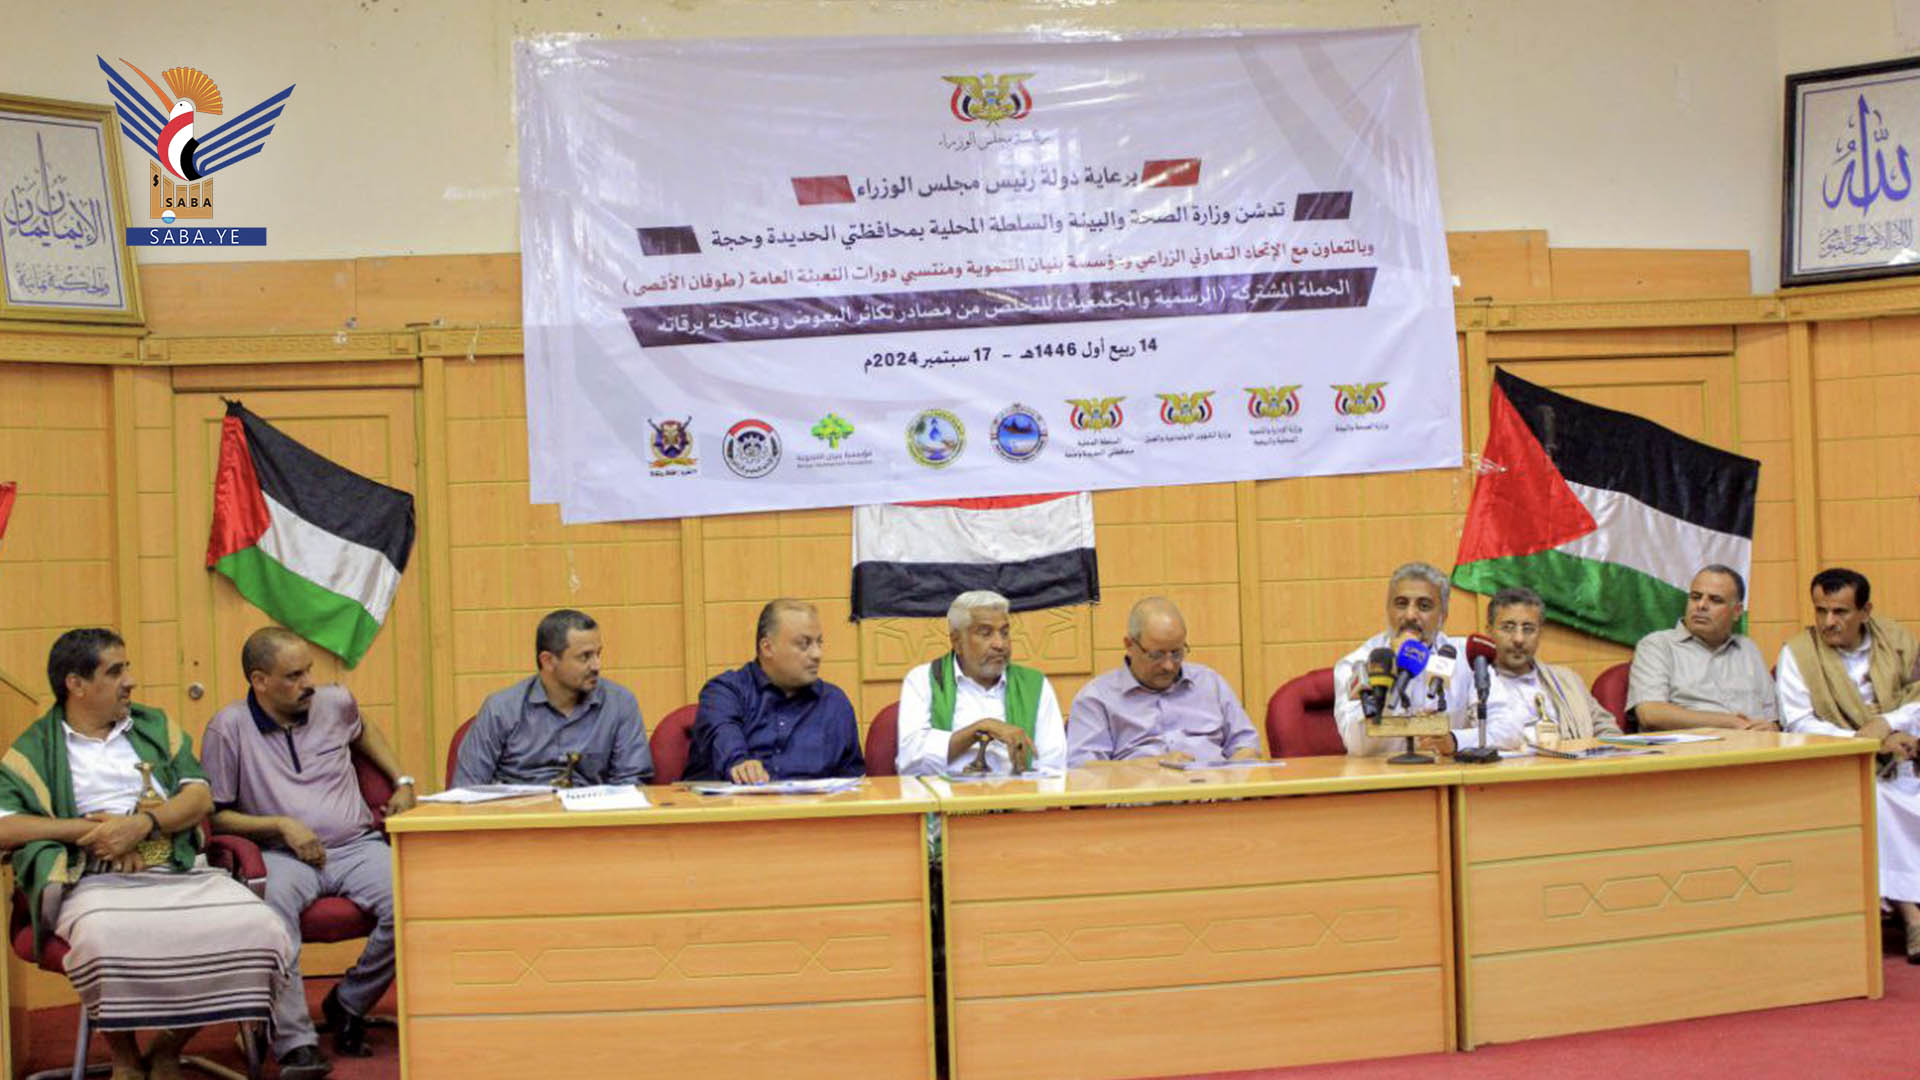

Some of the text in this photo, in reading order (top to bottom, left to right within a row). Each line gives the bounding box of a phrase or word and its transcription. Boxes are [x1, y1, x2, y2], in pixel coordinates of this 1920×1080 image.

[857, 167, 1138, 200] برعاية دولة رئيس مجلس الوزراء
[711, 202, 1286, 251] تدشن وزارة الصحة والبيئة والسلطة المحلية بمحافظتي الحديدة وحجة
[1189, 246, 1240, 266] التعاوني
[1291, 246, 1309, 264] مع
[1311, 238, 1375, 258] وبالتعاون
[1138, 249, 1186, 273] الزراعي
[688, 271, 744, 292] (طوفان
[750, 269, 794, 286] العامة
[852, 265, 896, 284] دورات
[901, 262, 962, 286] ومنتسبي
[1155, 285, 1225, 309] (الرسمية
[1231, 280, 1295, 304] المشتركة
[1298, 278, 1351, 297] الحملة
[784, 303, 852, 330] البعوض
[856, 302, 894, 326] تكاثر
[896, 302, 951, 324] مصادر
[956, 301, 980, 320] من
[985, 293, 1052, 319] للتخلص
[657, 314, 704, 336] يرقاته
[708, 308, 780, 331] ومكافحة
[973, 346, 992, 361] 17
[1081, 337, 1106, 359] أول
[1108, 344, 1136, 362] ربيع
[1139, 338, 1157, 351] 14
[864, 352, 918, 374] 2024م
[920, 353, 970, 370] سبتمبر
